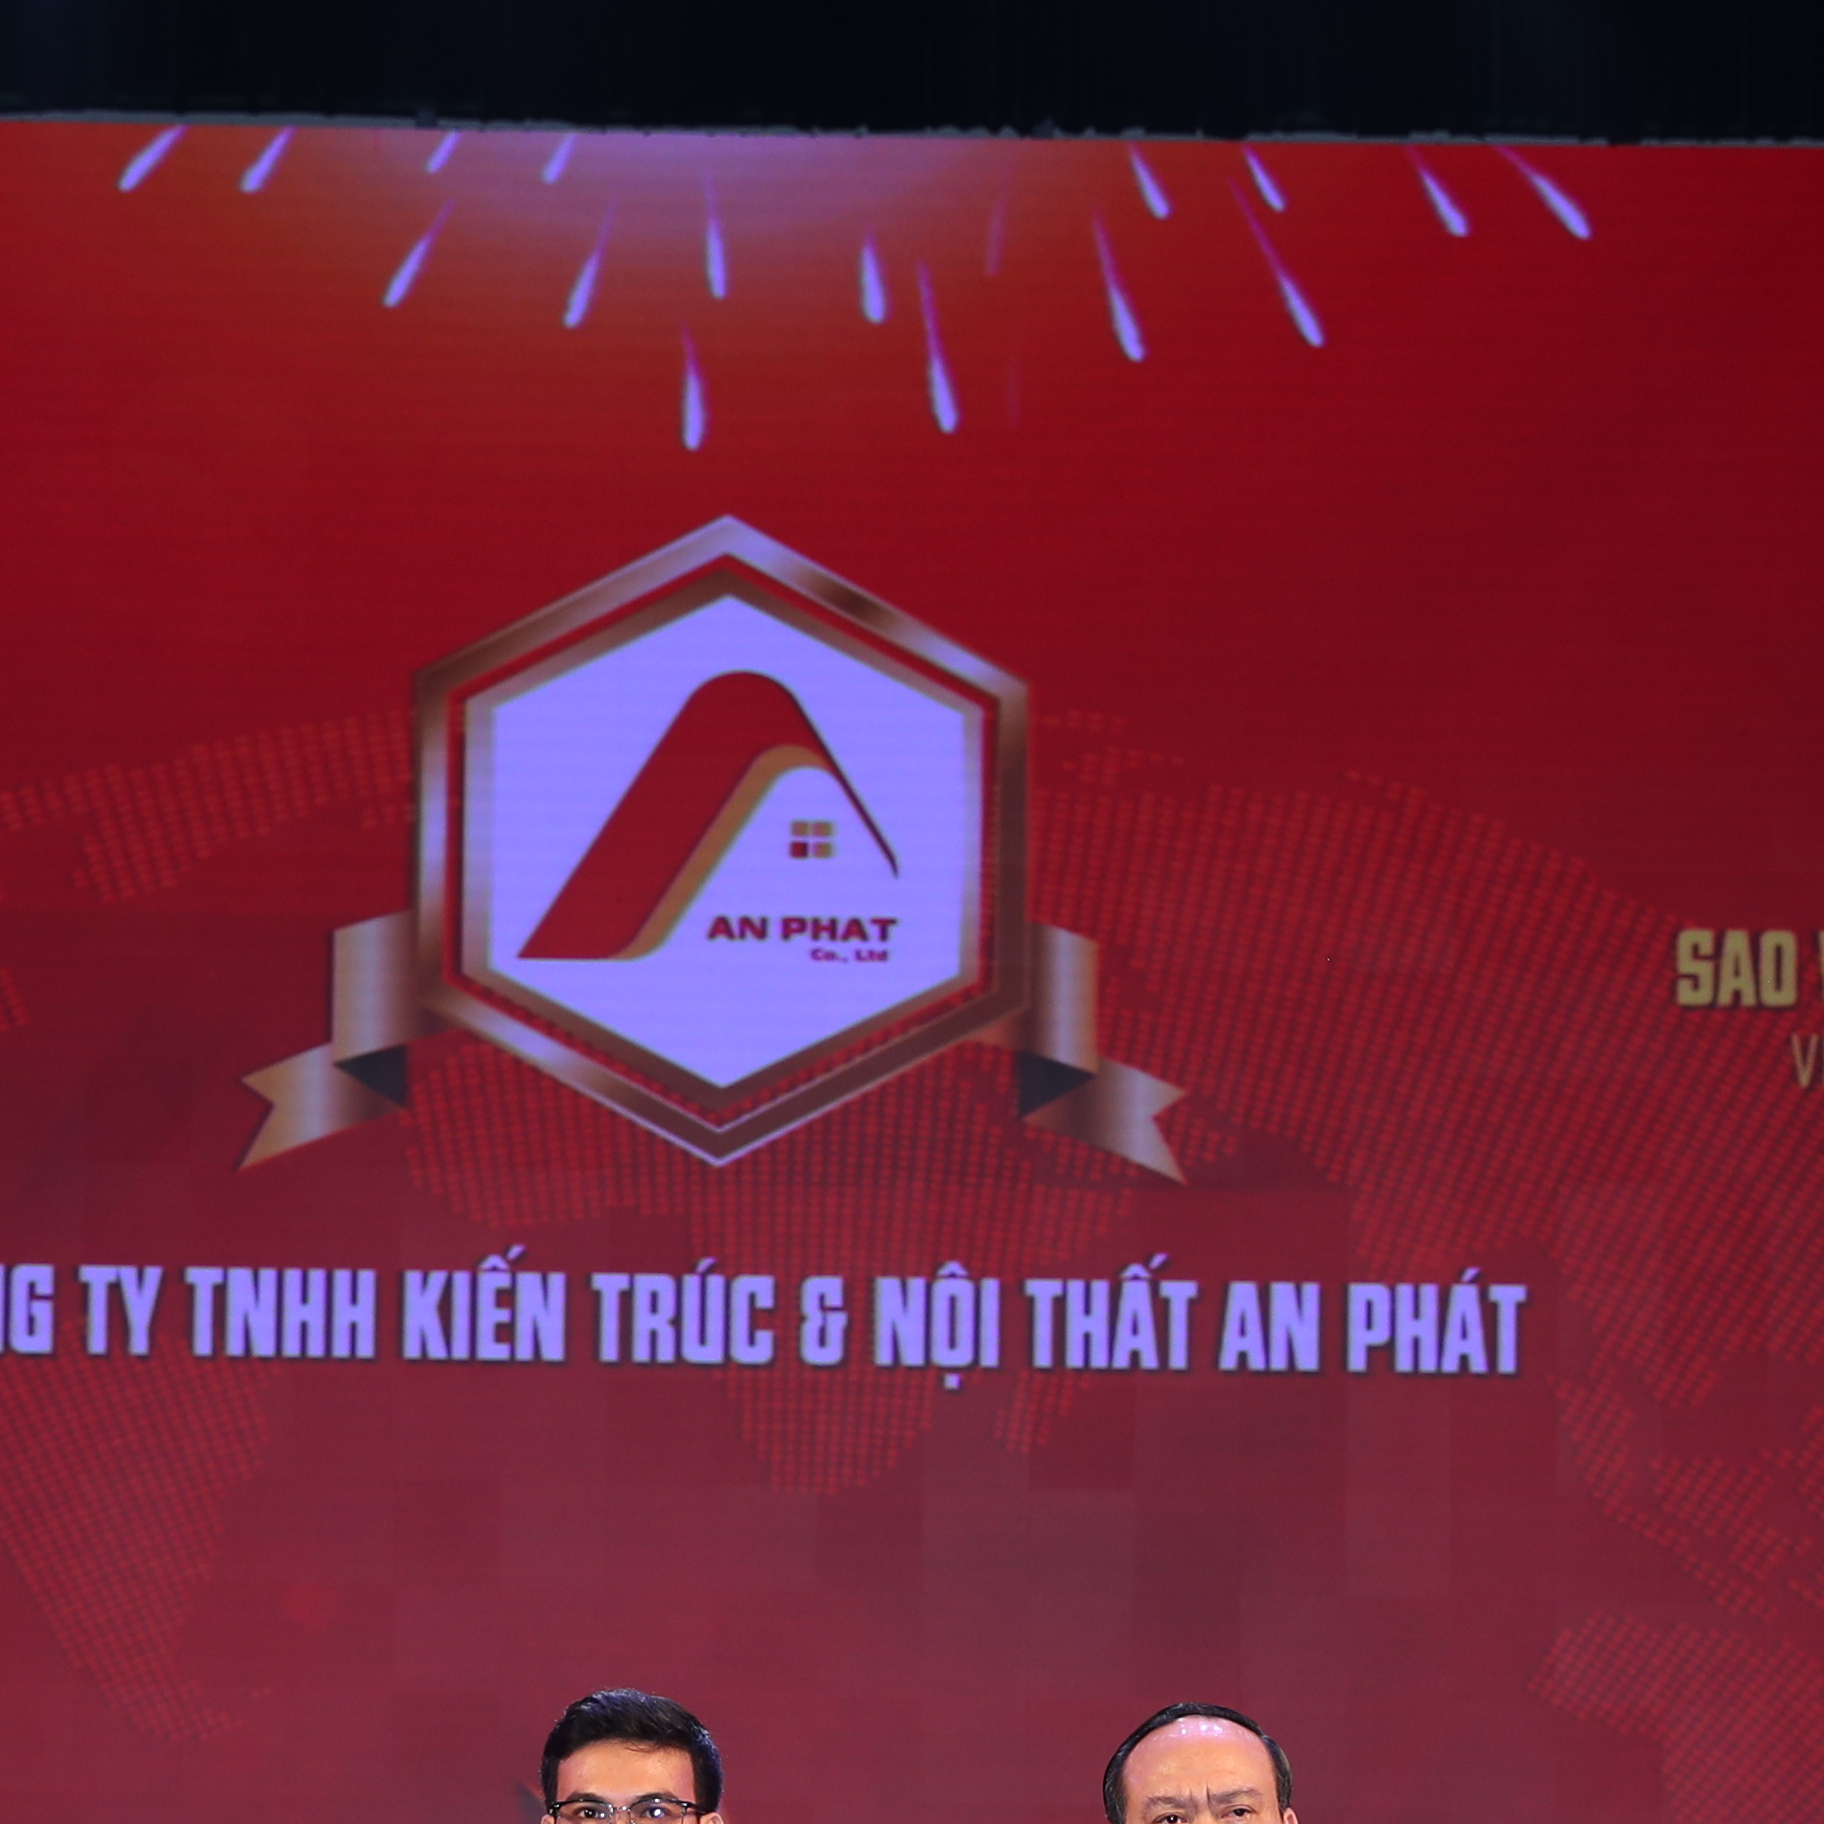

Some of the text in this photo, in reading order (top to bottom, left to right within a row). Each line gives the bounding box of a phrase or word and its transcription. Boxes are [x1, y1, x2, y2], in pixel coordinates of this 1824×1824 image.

[707, 915, 897, 942] AN PHAT
[854, 948, 889, 963] Ltd
[1677, 929, 1796, 1006] SAO
[80, 1265, 162, 1355] TY
[186, 1267, 376, 1358] TNHH
[404, 1245, 566, 1361] KIẾN
[592, 1257, 774, 1364] TRÚC
[801, 1276, 847, 1365] &
[876, 1261, 1000, 1388] NỘI
[1026, 1253, 1198, 1369] THẤT
[1220, 1282, 1320, 1370] AN
[1348, 1267, 1527, 1373] PHÁT
